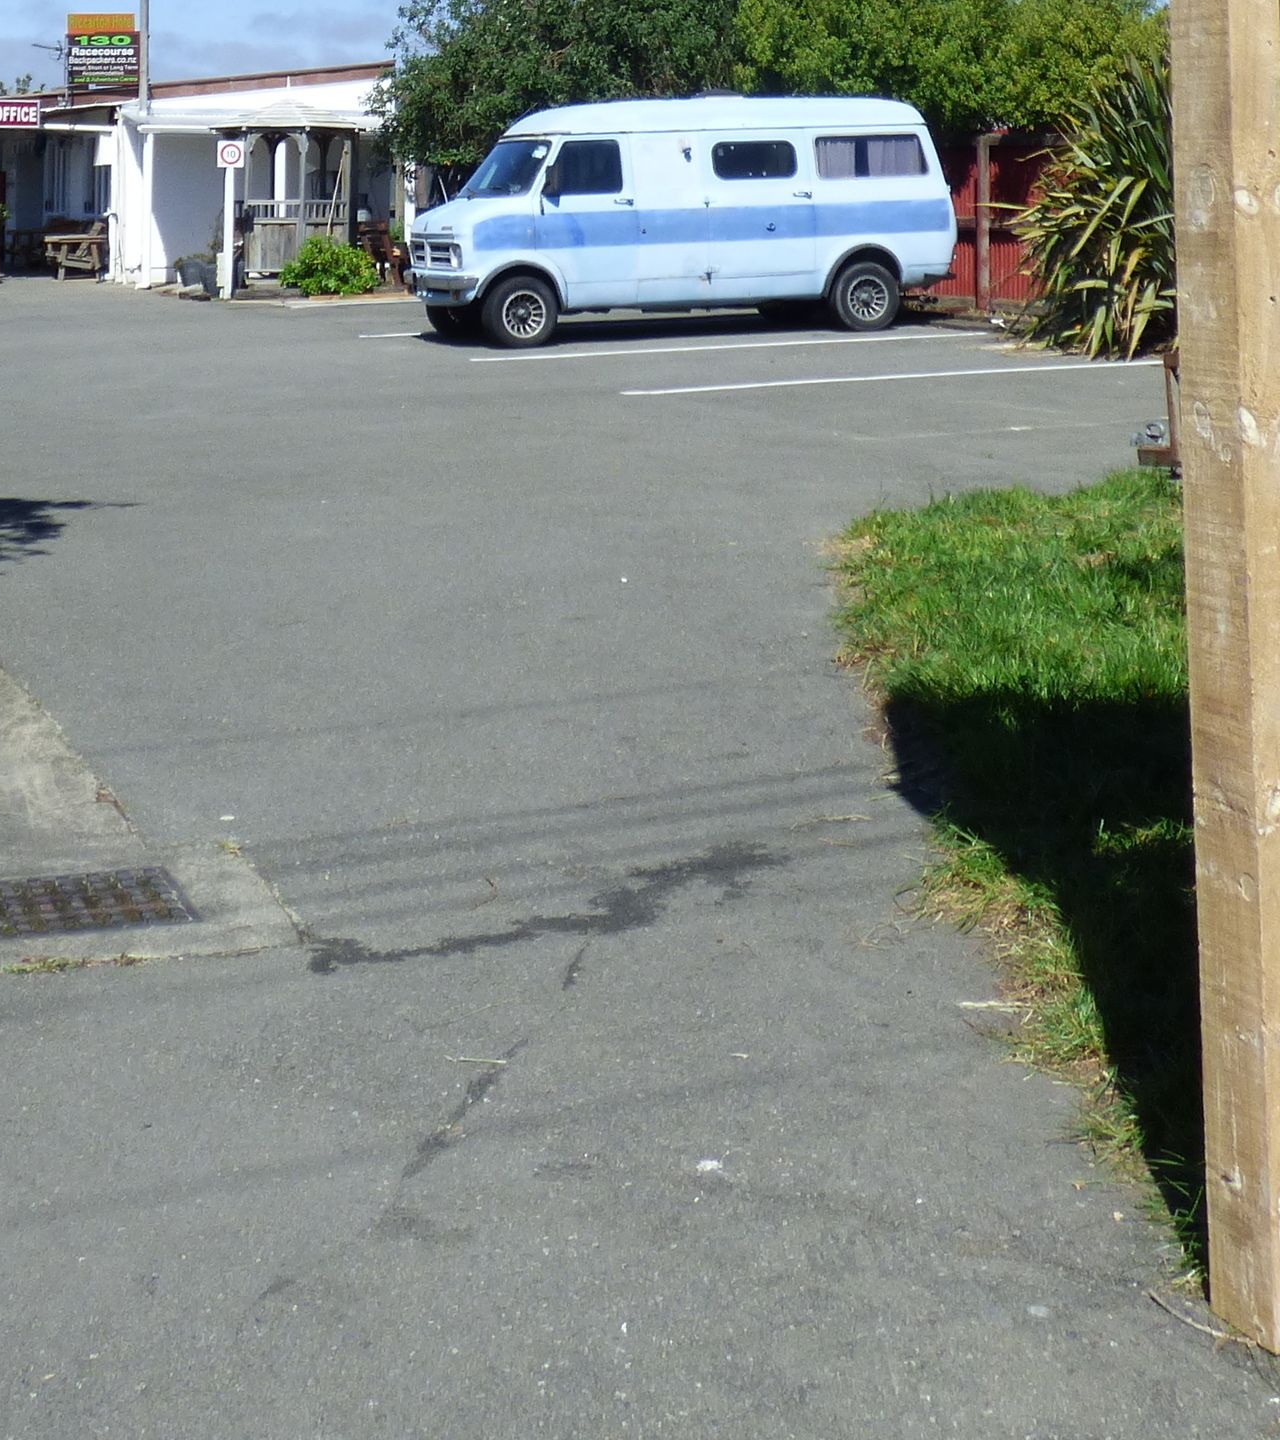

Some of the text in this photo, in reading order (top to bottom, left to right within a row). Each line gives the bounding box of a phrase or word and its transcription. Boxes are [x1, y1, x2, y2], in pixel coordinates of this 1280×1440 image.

[74, 35, 132, 46] 130
[71, 47, 134, 56] Racecourse
[68, 56, 137, 65] Backpackers.co.nz
[226, 149, 236, 159] 10
